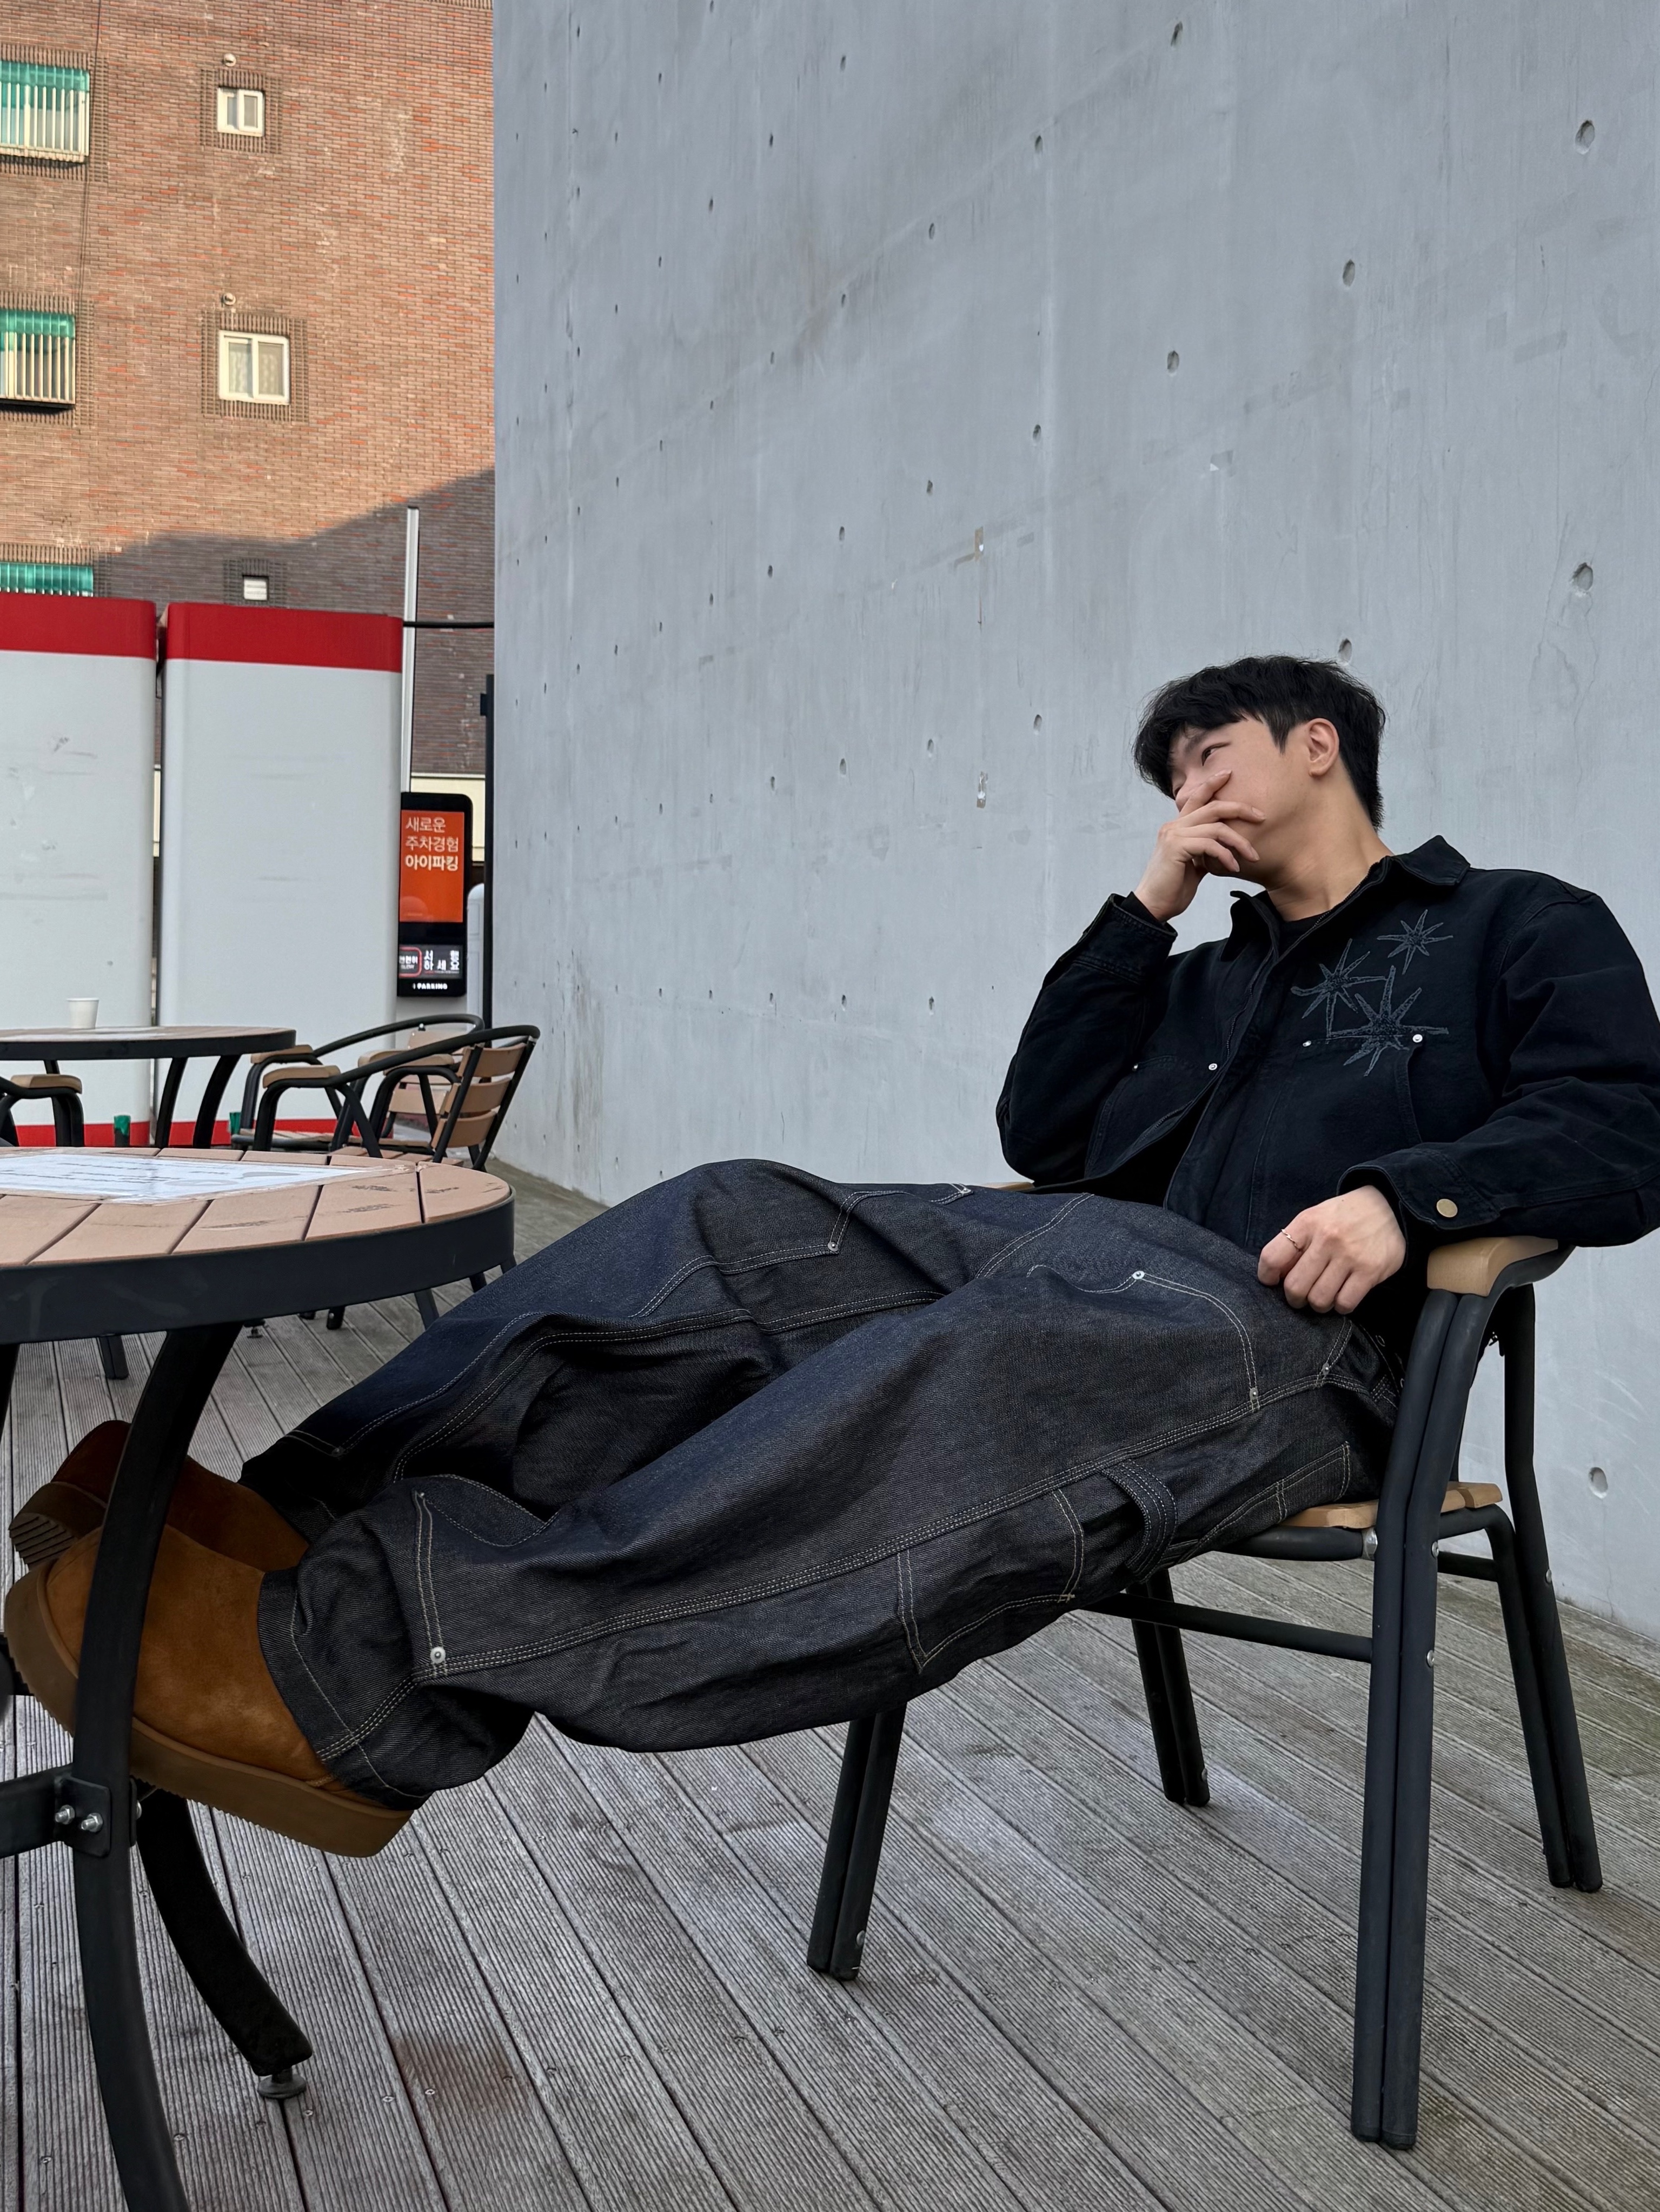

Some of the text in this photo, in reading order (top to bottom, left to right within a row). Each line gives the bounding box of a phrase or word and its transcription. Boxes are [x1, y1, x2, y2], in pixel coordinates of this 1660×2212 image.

[406, 817, 446, 833] 새로운
[406, 836, 459, 852] 주차경험
[406, 855, 459, 871] 아이파킹
